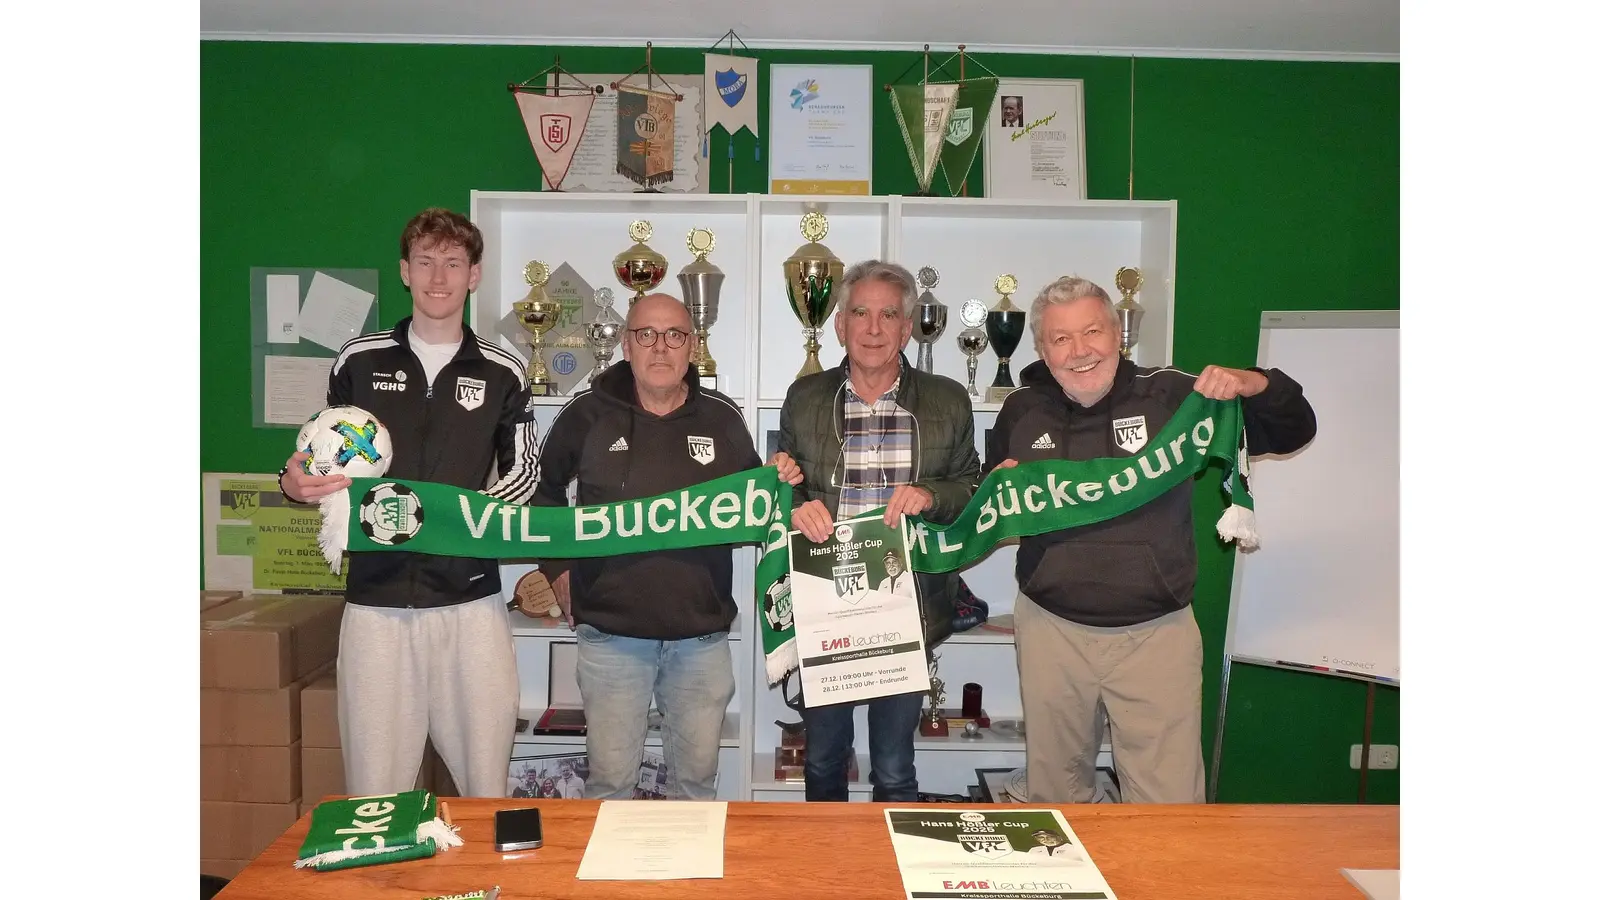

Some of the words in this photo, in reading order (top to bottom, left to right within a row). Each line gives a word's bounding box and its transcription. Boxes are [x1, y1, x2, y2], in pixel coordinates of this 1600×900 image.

[723, 76, 744, 95] MORA
[637, 118, 655, 132] VTB
[372, 381, 398, 391] VGH
[459, 494, 551, 542] VfL
[810, 547, 831, 556] Hans
[832, 542, 863, 553] Hößler
[864, 540, 883, 548] Cup
[836, 551, 859, 561] 2025
[821, 637, 851, 651] EMB
[852, 631, 902, 647] Leuchten
[832, 651, 868, 661] Kreissporthalle
[868, 648, 894, 657] Bückeburg
[878, 666, 906, 675] Vorrunde
[822, 685, 841, 693] 28.12.
[845, 682, 863, 690] 13:00
[879, 676, 909, 685] Endrunde
[956, 820, 1000, 828] Hößler
[1003, 821, 1030, 829] Cup
[942, 880, 990, 889] EMB
[992, 880, 1073, 890] Leuchten
